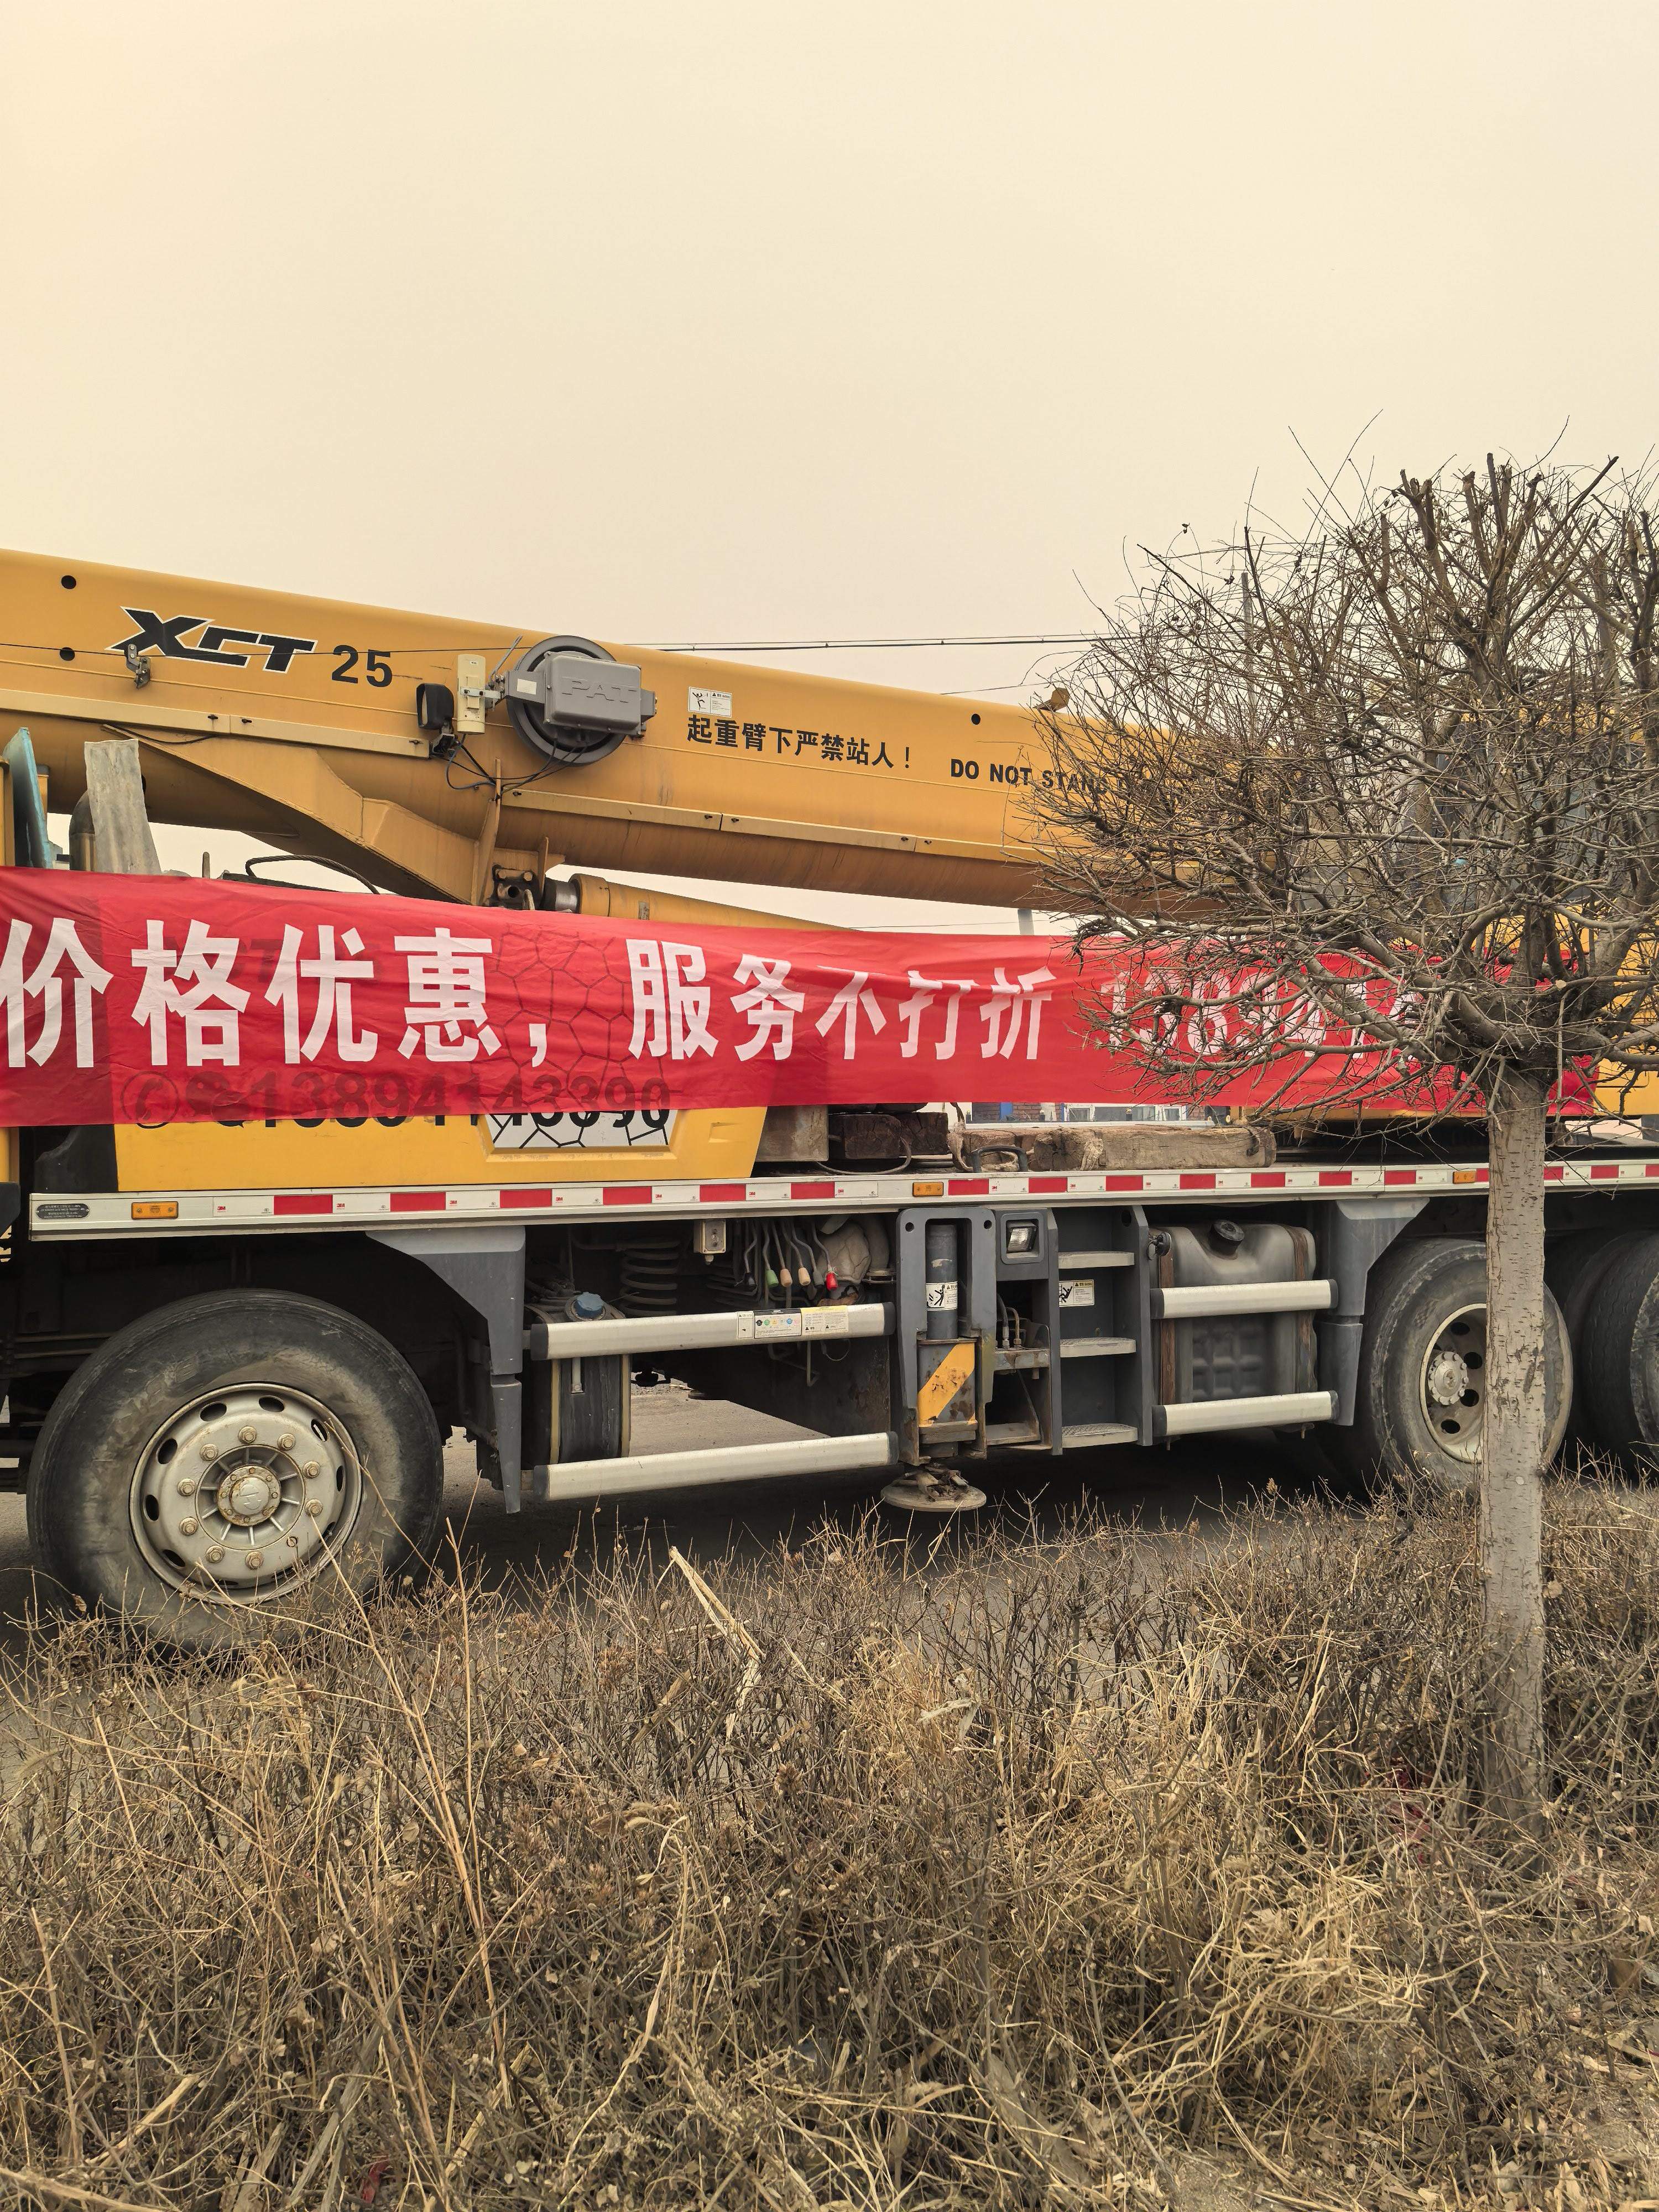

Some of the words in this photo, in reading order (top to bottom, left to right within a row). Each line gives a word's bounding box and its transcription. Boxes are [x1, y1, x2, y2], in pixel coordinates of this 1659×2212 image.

[104, 607, 319, 674] XCT
[332, 645, 393, 687] 25
[951, 759, 979, 780] DO
[990, 763, 1032, 786] NOT
